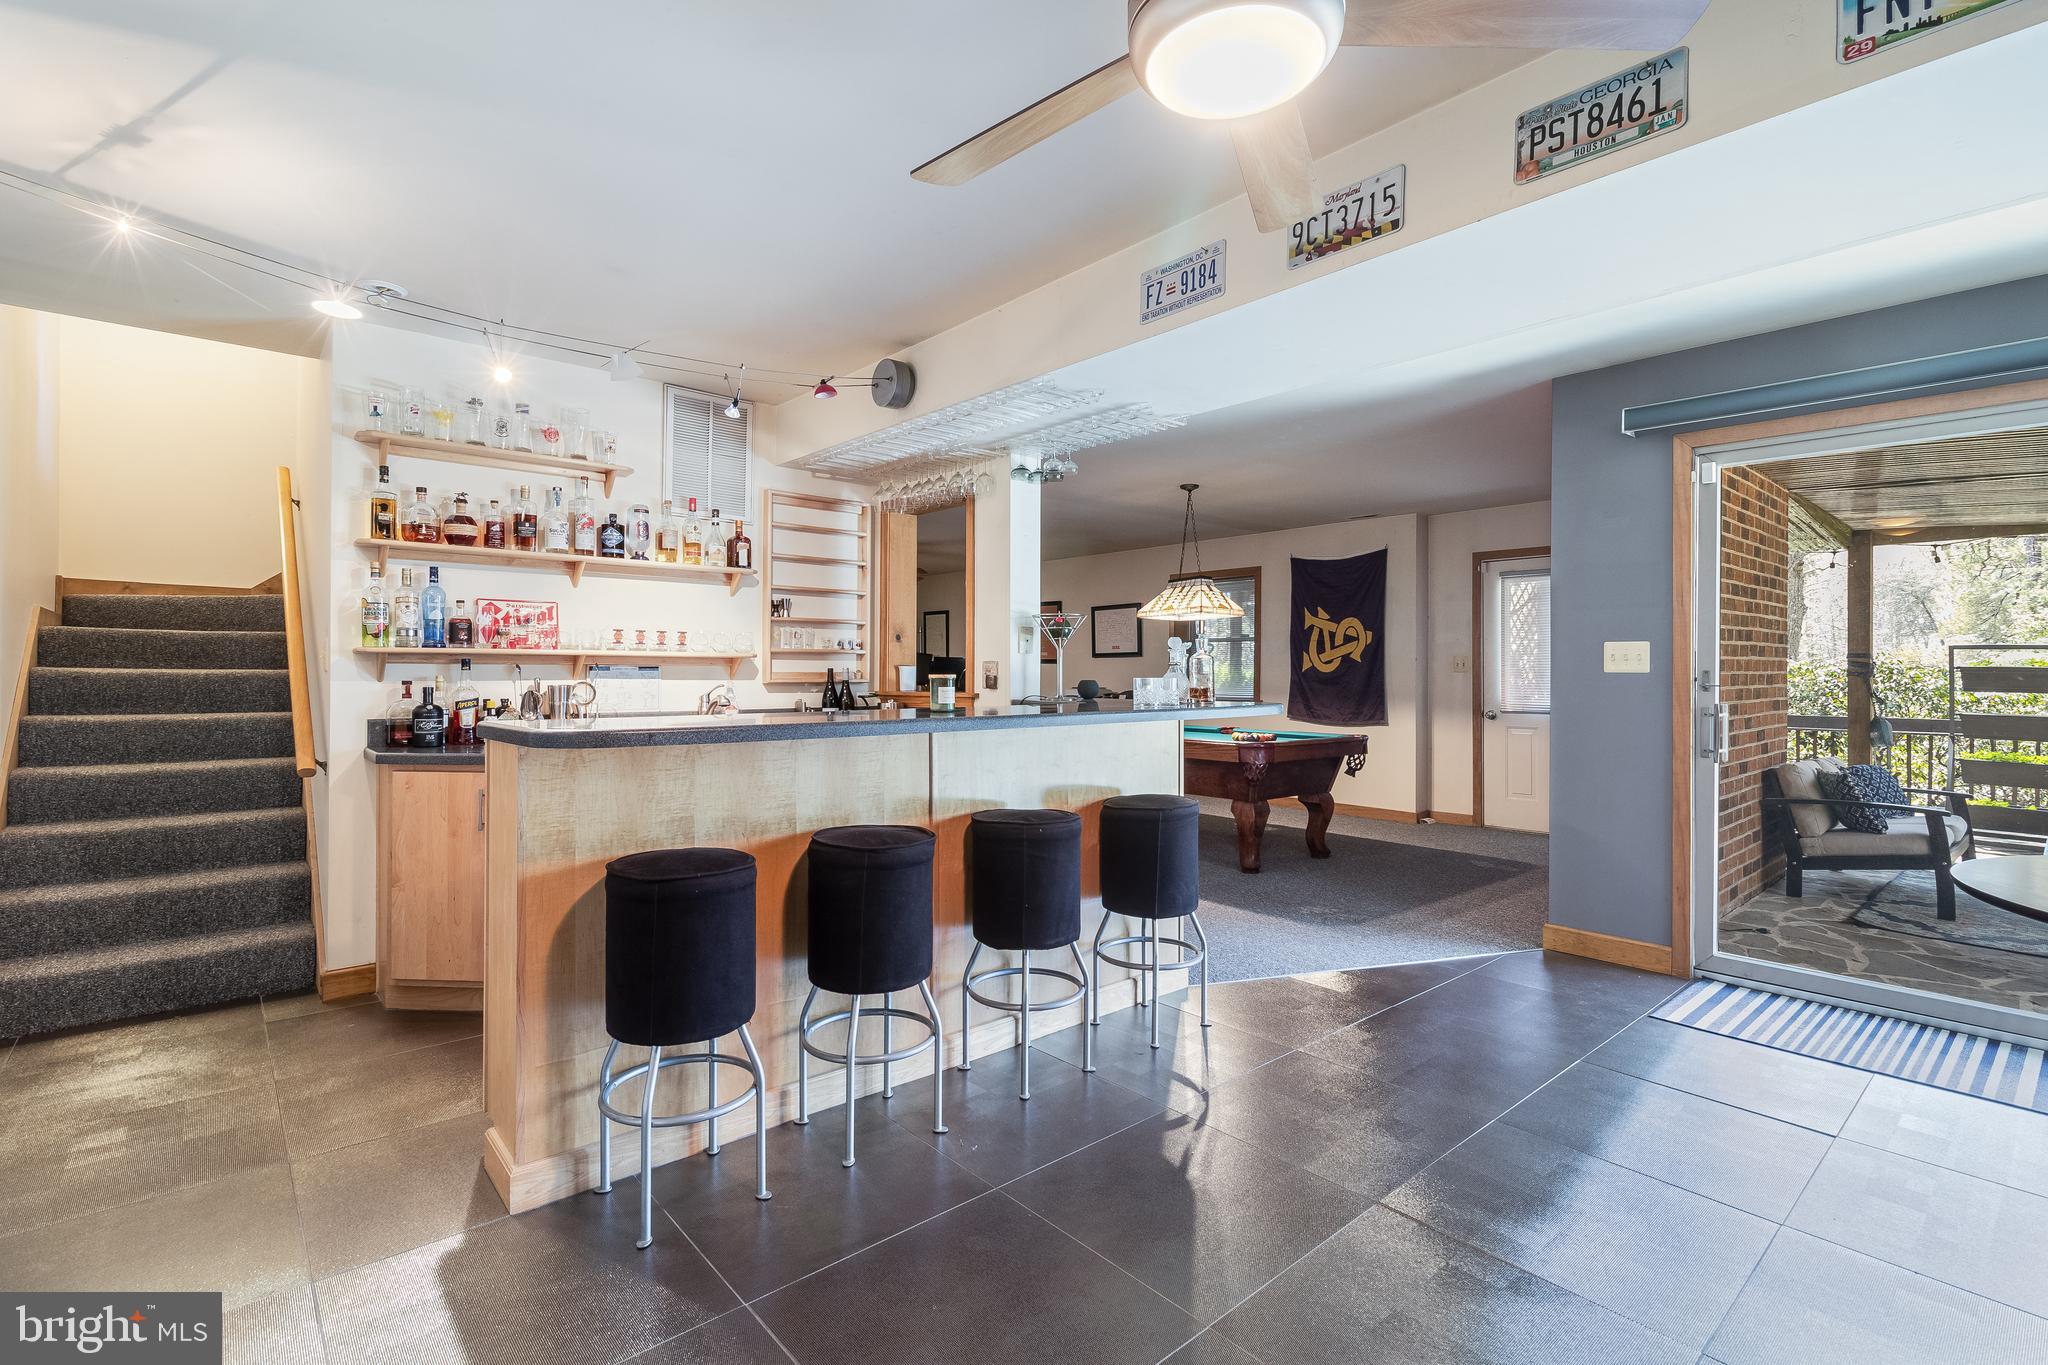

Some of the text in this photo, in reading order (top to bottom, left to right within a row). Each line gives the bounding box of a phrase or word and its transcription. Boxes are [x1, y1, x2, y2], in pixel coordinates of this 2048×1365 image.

[1847, 40, 1873, 58] 29
[1579, 58, 1674, 105] GEORGIA
[1529, 77, 1667, 161] PST8461
[1655, 111, 1673, 125] JAN
[1574, 134, 1617, 158] HOUSTON
[1325, 182, 1362, 205] Maryland
[1292, 183, 1396, 251] 9CT3715
[1195, 251, 1204, 261] DC
[1146, 258, 1217, 309] FZ 9184
